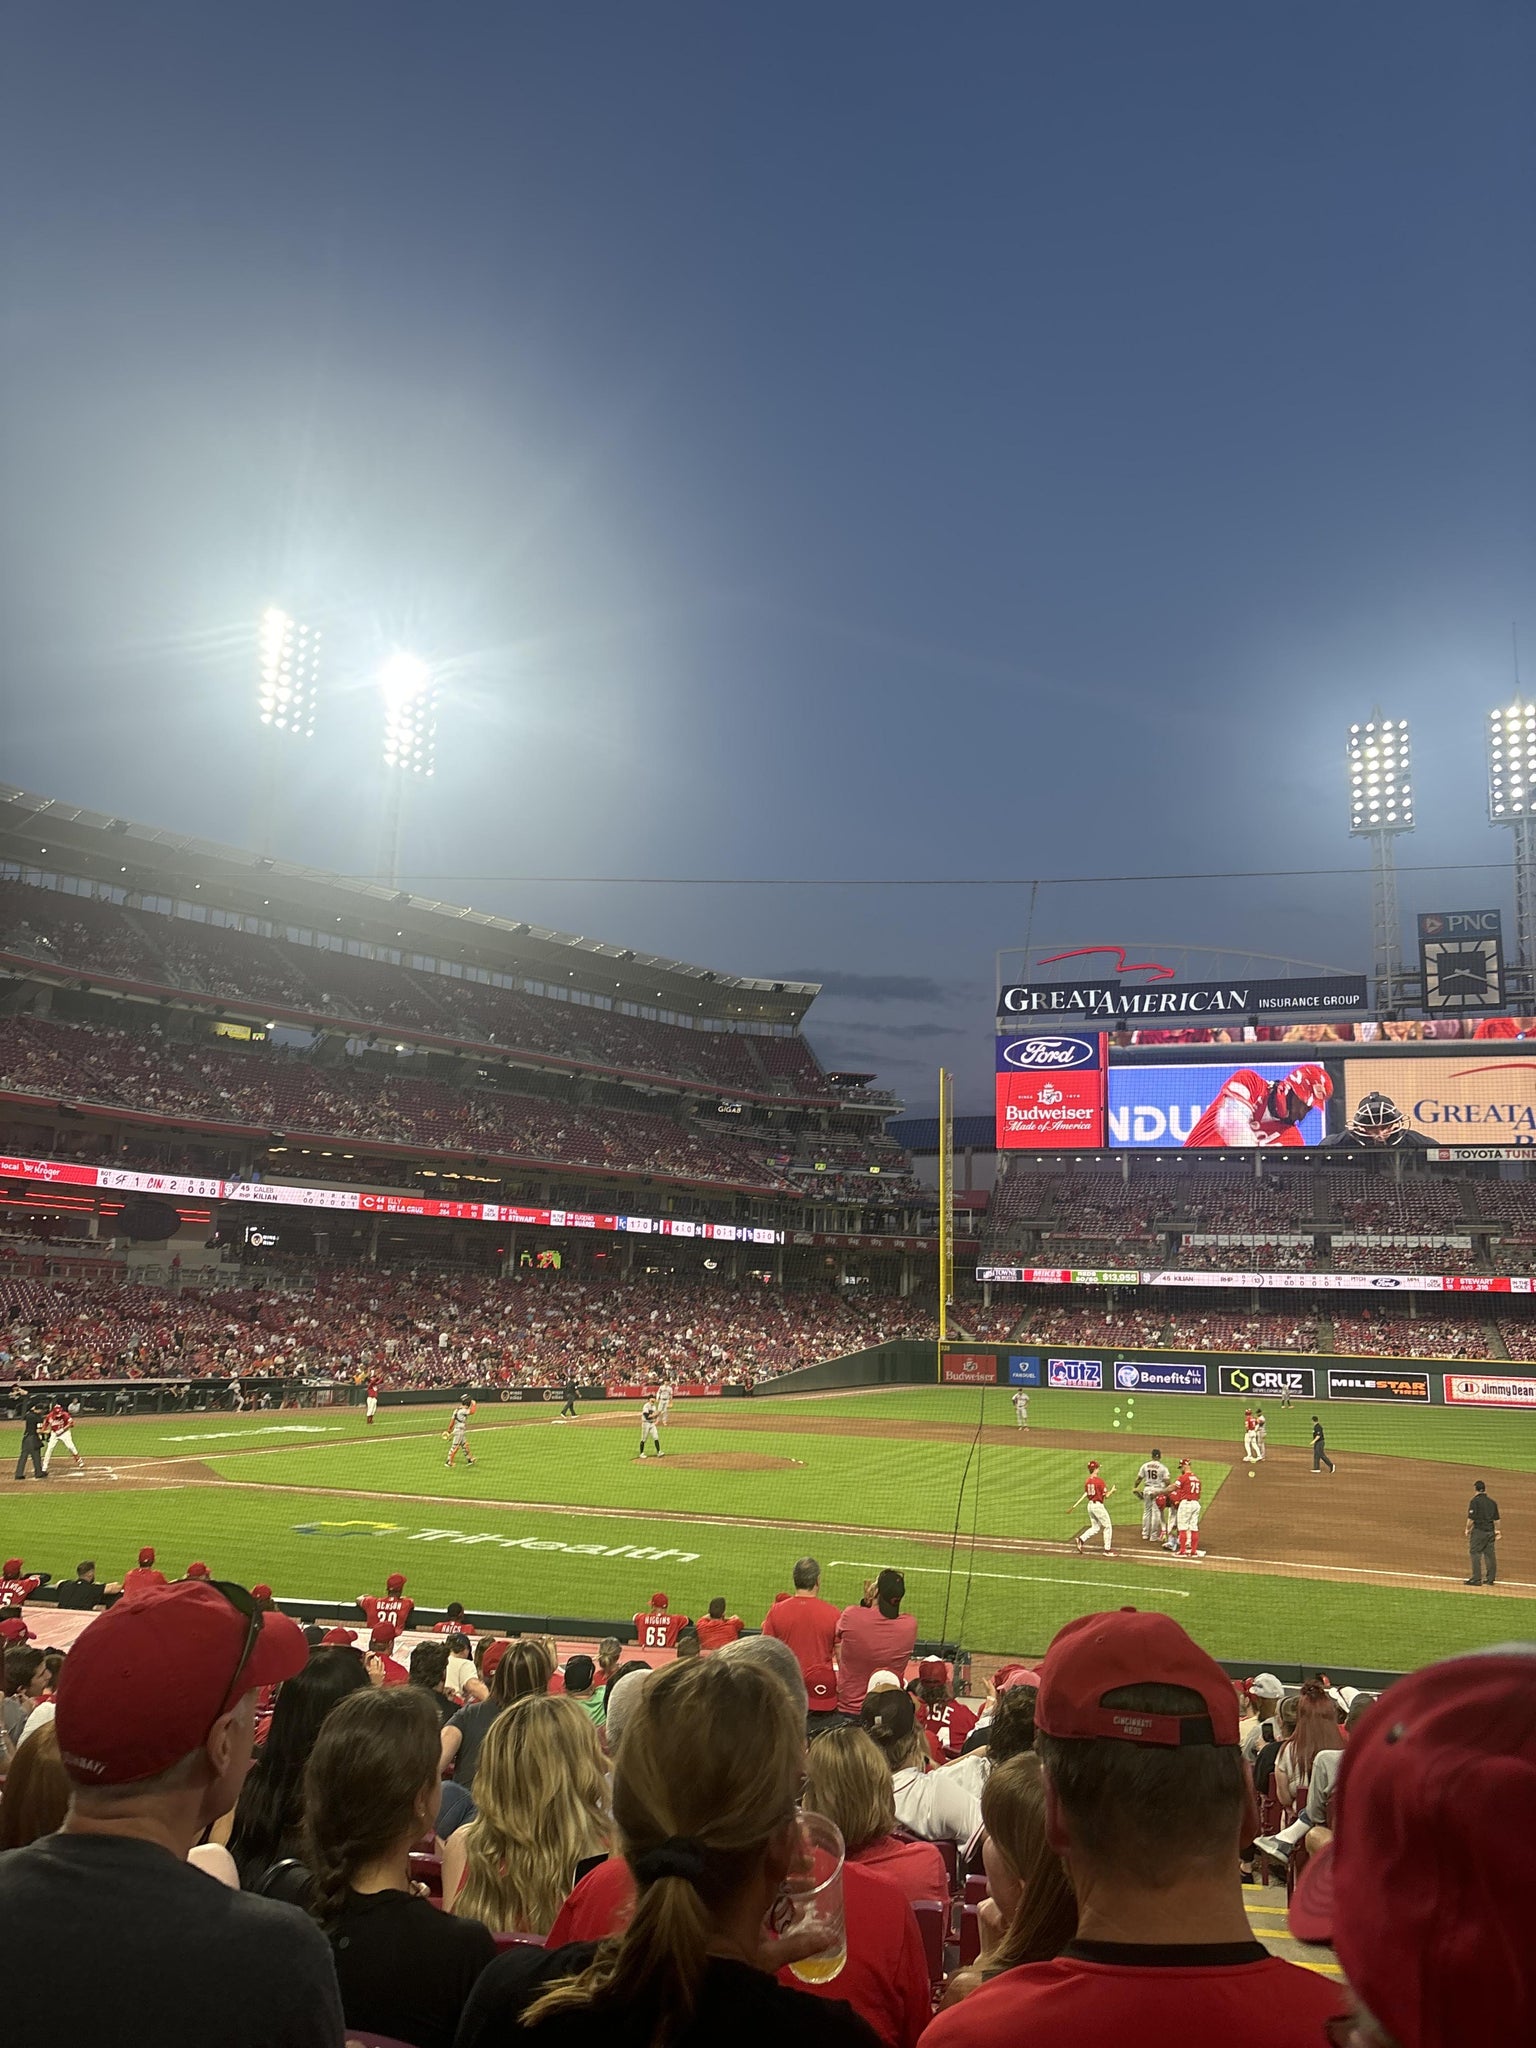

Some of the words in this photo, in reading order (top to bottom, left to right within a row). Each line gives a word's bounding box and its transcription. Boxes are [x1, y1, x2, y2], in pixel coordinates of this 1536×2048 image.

[1445, 913, 1498, 932] PNC
[1259, 996, 1320, 1008] INSURANCE
[1323, 995, 1360, 1006] GROUP
[1020, 1041, 1076, 1064] Ford
[1005, 1105, 1094, 1120] Budweiser
[1005, 1121, 1036, 1132] Made
[1037, 1121, 1048, 1132] of
[1047, 1120, 1092, 1131] America
[1454, 1150, 1502, 1159] TOYOTA
[1, 1162, 20, 1171] local
[34, 1162, 60, 1181] Kroger
[102, 1177, 108, 1186] 6
[147, 1178, 165, 1190] CIN
[170, 1180, 178, 1191] 2
[188, 1186, 194, 1194] 0
[199, 1187, 205, 1195] 0
[210, 1188, 216, 1196] 0
[253, 1193, 278, 1202] KILIAN
[508, 1215, 537, 1223] STEWART
[1102, 1273, 1137, 1282] $13,955
[945, 1370, 995, 1381] Budweiser
[1140, 1371, 1191, 1384] Benefits
[1187, 1369, 1201, 1377] ALL
[1191, 1377, 1201, 1385] IN
[1252, 1372, 1303, 1389] CRUZ
[1481, 1385, 1512, 1396] Jimmy
[1512, 1386, 1534, 1396] Dean
[1147, 1469, 1158, 1480] 16
[1190, 1481, 1200, 1494] 75
[407, 1527, 701, 1562] TriHealth
[376, 1601, 403, 1611] BENSON
[644, 1616, 671, 1625] HIGGINS
[645, 1626, 667, 1646] 65
[1112, 1716, 1153, 1728] CINCINNATI
[1123, 1727, 1143, 1736] REDS
